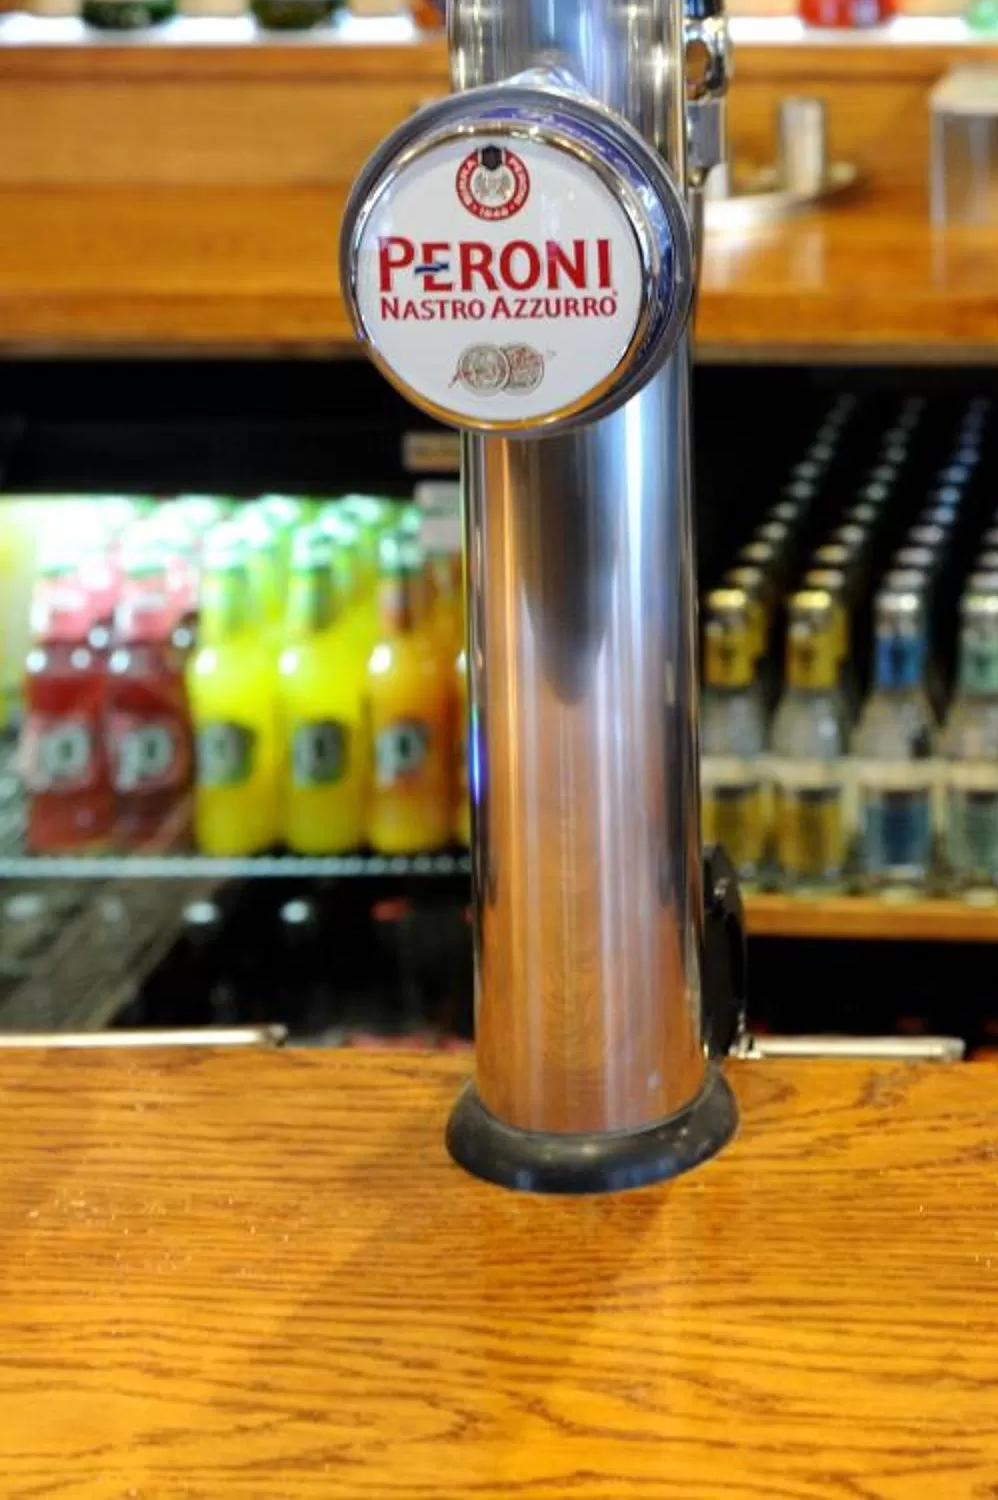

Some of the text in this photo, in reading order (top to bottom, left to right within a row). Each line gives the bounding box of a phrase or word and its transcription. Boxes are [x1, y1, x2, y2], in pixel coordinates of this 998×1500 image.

[377, 236, 612, 292] PERONI
[381, 295, 618, 321] NASTRO AZZURRO
